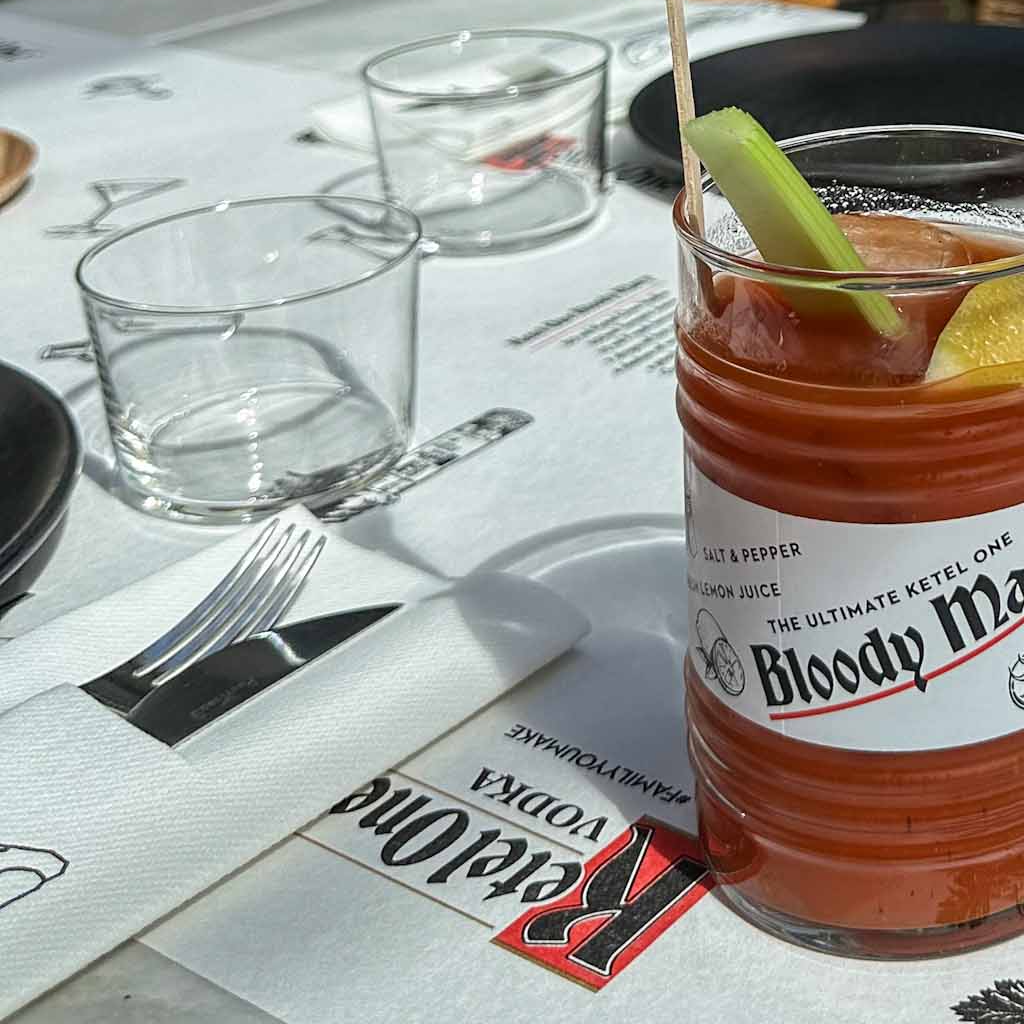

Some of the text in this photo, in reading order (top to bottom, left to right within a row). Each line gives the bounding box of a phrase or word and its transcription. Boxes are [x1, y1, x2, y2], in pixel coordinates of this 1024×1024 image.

[703, 542, 802, 564] SALT & PEPPER
[767, 531, 1014, 634] THE ULTIMATE KETEL ONE
[701, 581, 735, 599] LEMON
[739, 582, 782, 599] JUICE
[749, 626, 928, 693] Bloody
[504, 724, 692, 805] #FAMILYYOUMAKE
[470, 767, 609, 843] VODKA
